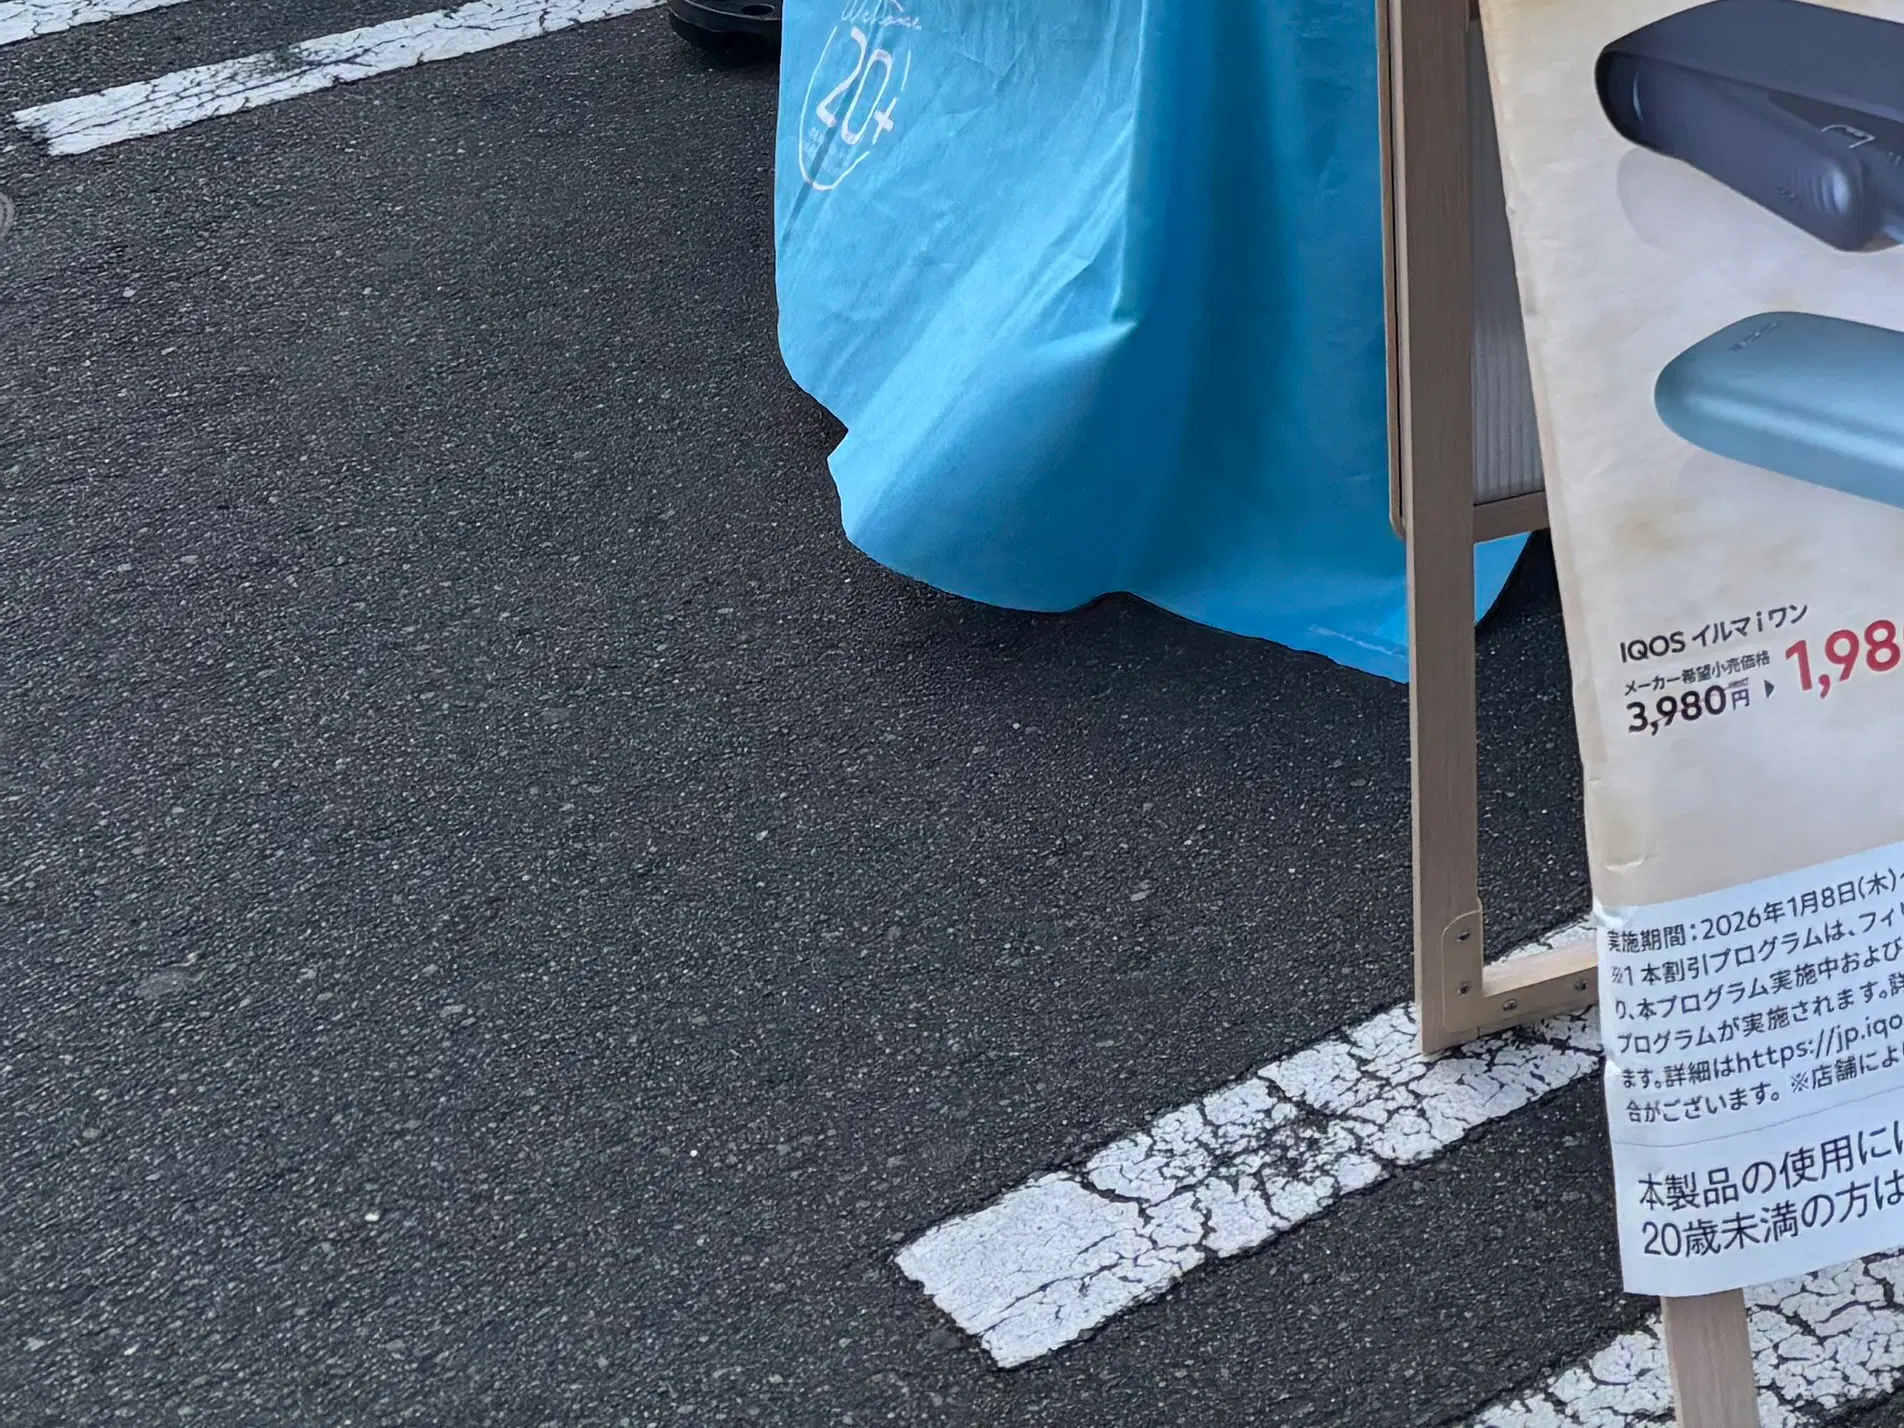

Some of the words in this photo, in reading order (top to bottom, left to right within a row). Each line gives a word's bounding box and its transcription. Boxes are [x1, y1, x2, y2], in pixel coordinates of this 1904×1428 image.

[1619, 633, 1686, 664] IQOS
[1691, 618, 1751, 648] イルマ
[1767, 603, 1809, 627] ワン
[1624, 650, 1771, 696] メーカー希望小売価格
